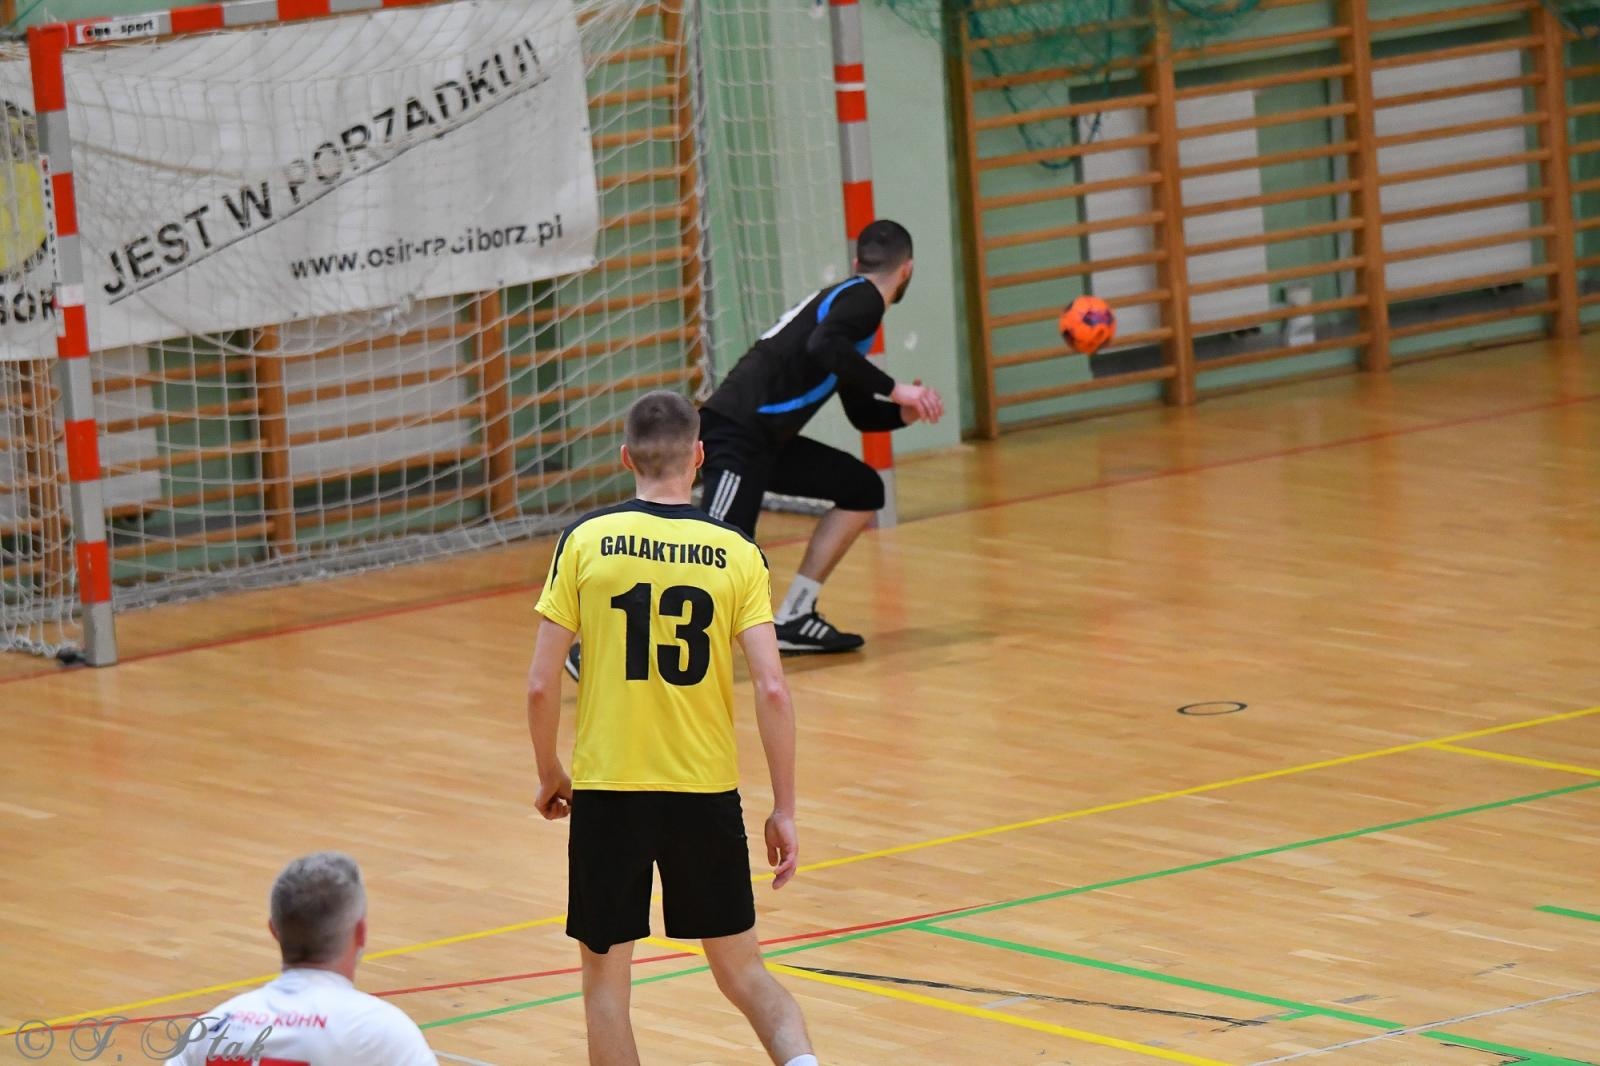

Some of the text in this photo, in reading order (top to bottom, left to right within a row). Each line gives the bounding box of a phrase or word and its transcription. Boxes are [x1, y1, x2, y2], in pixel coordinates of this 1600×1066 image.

[121, 20, 154, 34] sport
[104, 205, 212, 295] JEST
[222, 181, 273, 232] W
[600, 535, 727, 569] GALAKTIKOS
[610, 582, 715, 687] 13
